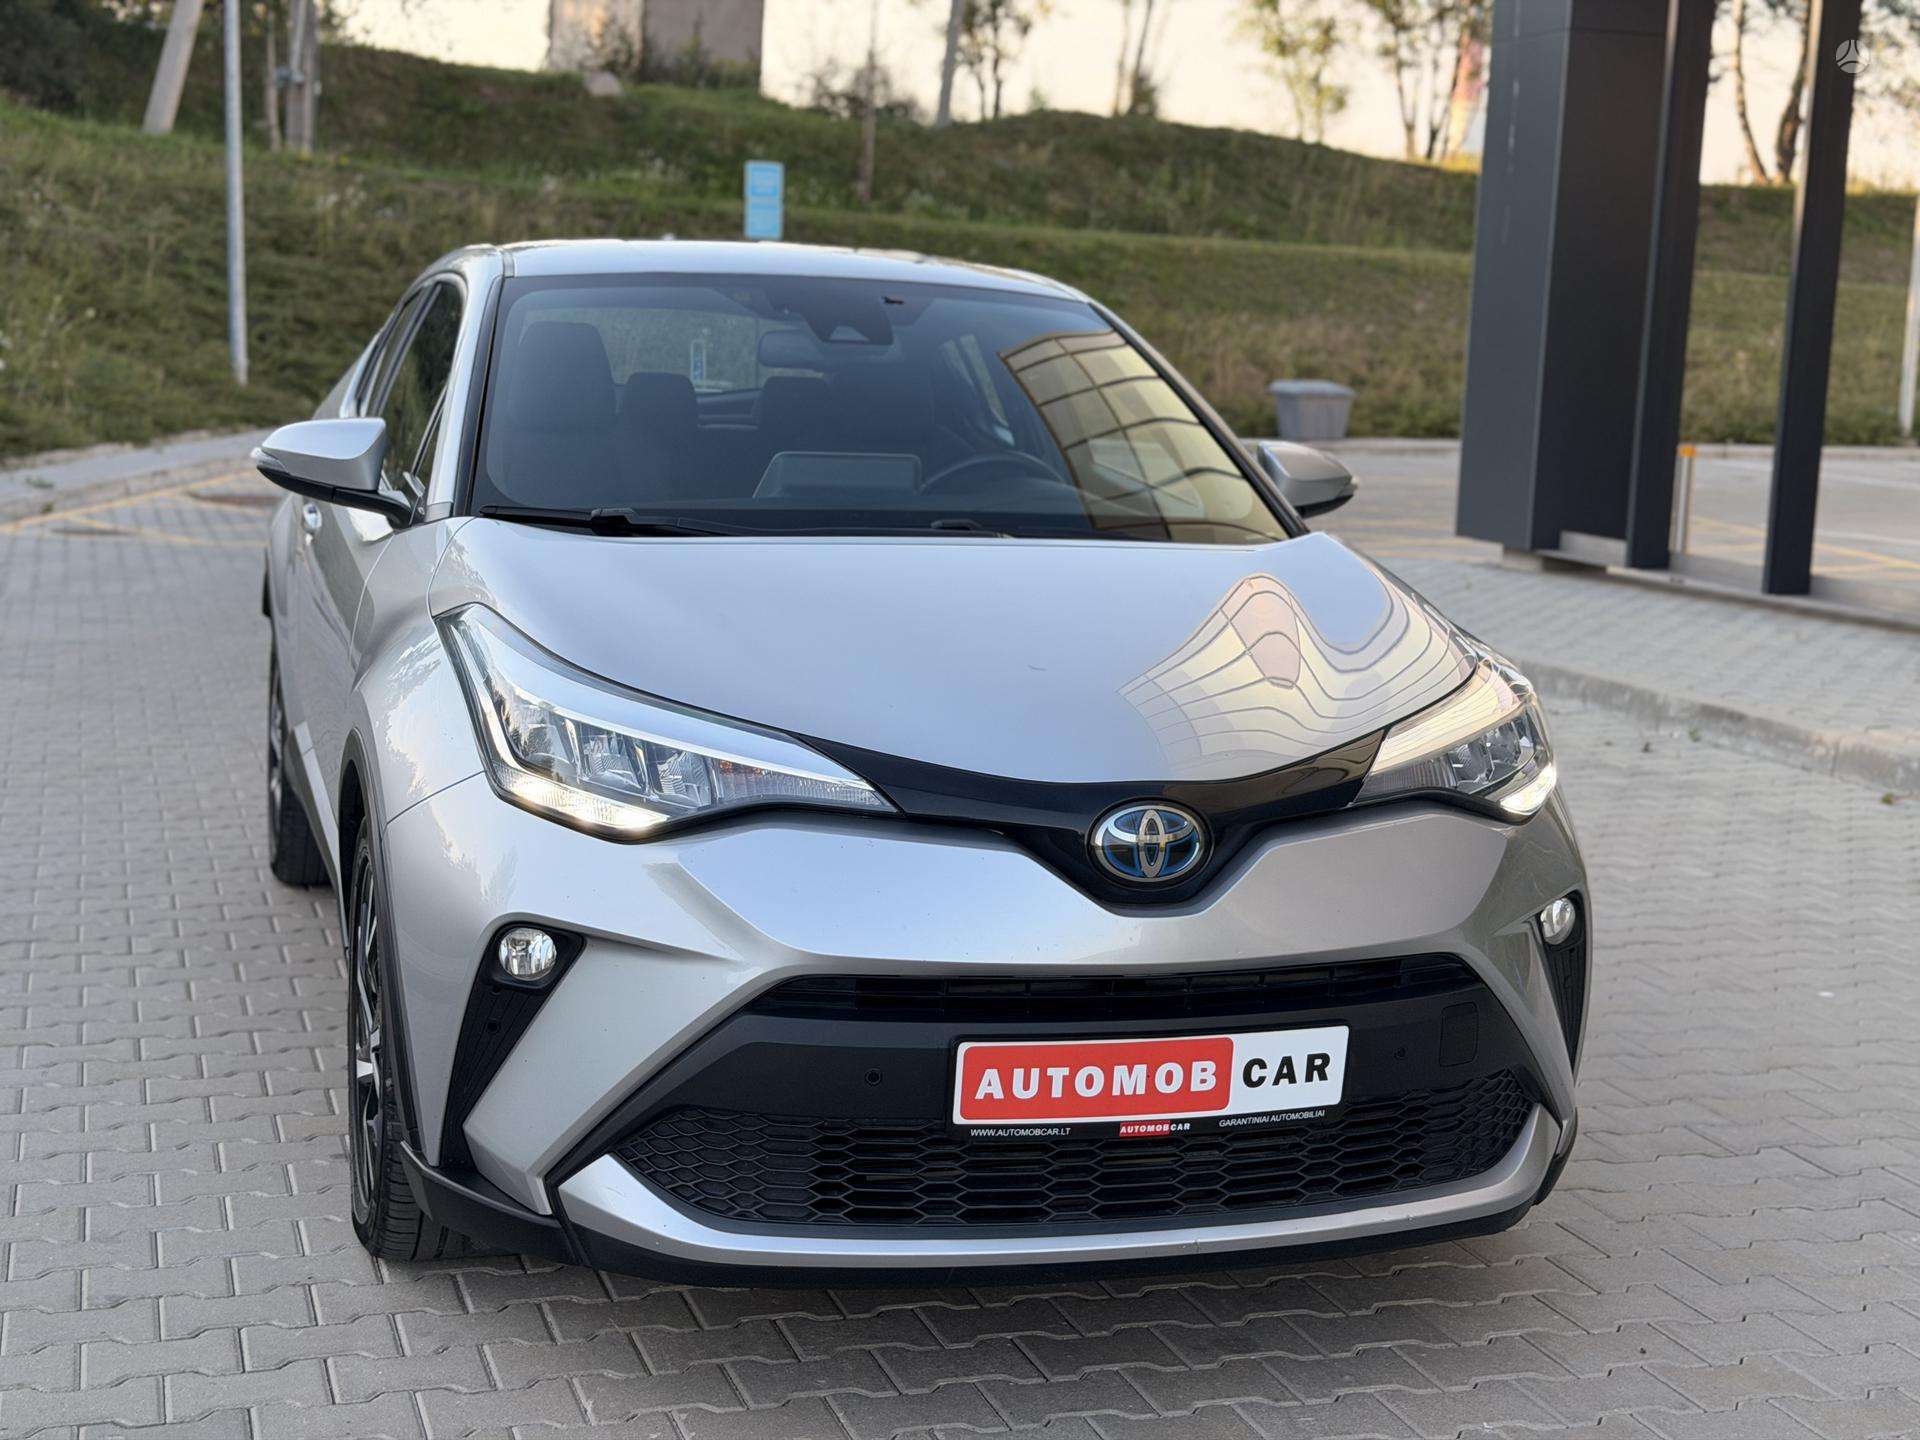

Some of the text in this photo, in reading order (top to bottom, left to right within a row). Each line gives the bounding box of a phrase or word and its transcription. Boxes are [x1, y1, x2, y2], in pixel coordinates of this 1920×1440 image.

[974, 1052, 1332, 1100] AUTOMOB CAR
[1218, 1109, 1325, 1127] GARANTINIAI AUTOMOBILIAI
[970, 1127, 1072, 1137] WWW.AUTOMOBCAR.LT
